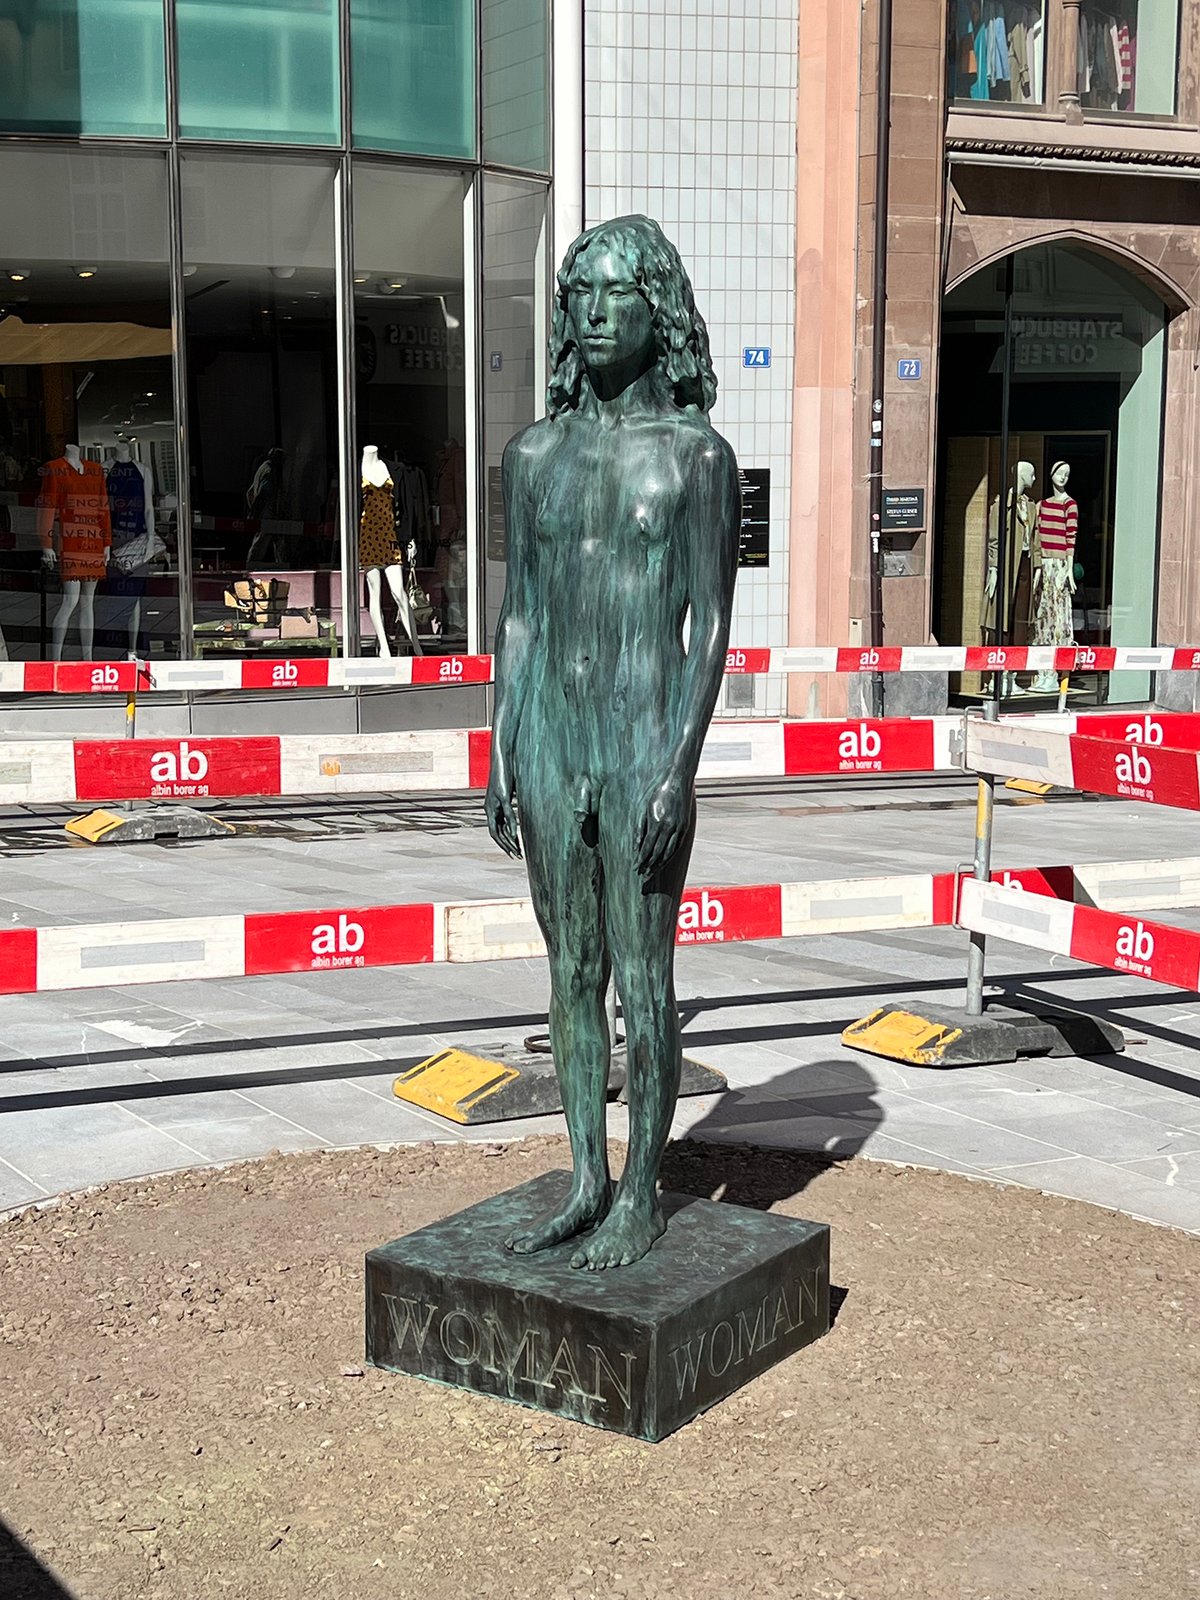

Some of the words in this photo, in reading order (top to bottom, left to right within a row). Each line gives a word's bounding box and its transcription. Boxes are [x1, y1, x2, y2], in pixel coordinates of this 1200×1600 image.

[749, 350, 765, 365] 74
[904, 362, 916, 376] 72
[725, 650, 746, 666] ab
[860, 648, 879, 665] ab
[987, 648, 1007, 664] ab
[1079, 648, 1096, 664] ab
[91, 665, 119, 684] ab
[272, 660, 298, 680] ab
[439, 657, 463, 675] ab
[1125, 714, 1163, 746] ab
[838, 722, 881, 758] ab
[150, 741, 208, 782] ab
[1115, 746, 1151, 785] ab
[151, 785, 171, 796] albin
[173, 784, 196, 796] borer
[198, 785, 208, 796] ag
[678, 891, 724, 929] ab
[311, 914, 364, 955] ab
[1115, 921, 1154, 962] ab
[311, 956, 330, 968] albin
[332, 955, 353, 966] borer
[354, 955, 365, 967] ag
[668, 1266, 821, 1400] WOMAN
[381, 1293, 637, 1409] WOMAN
